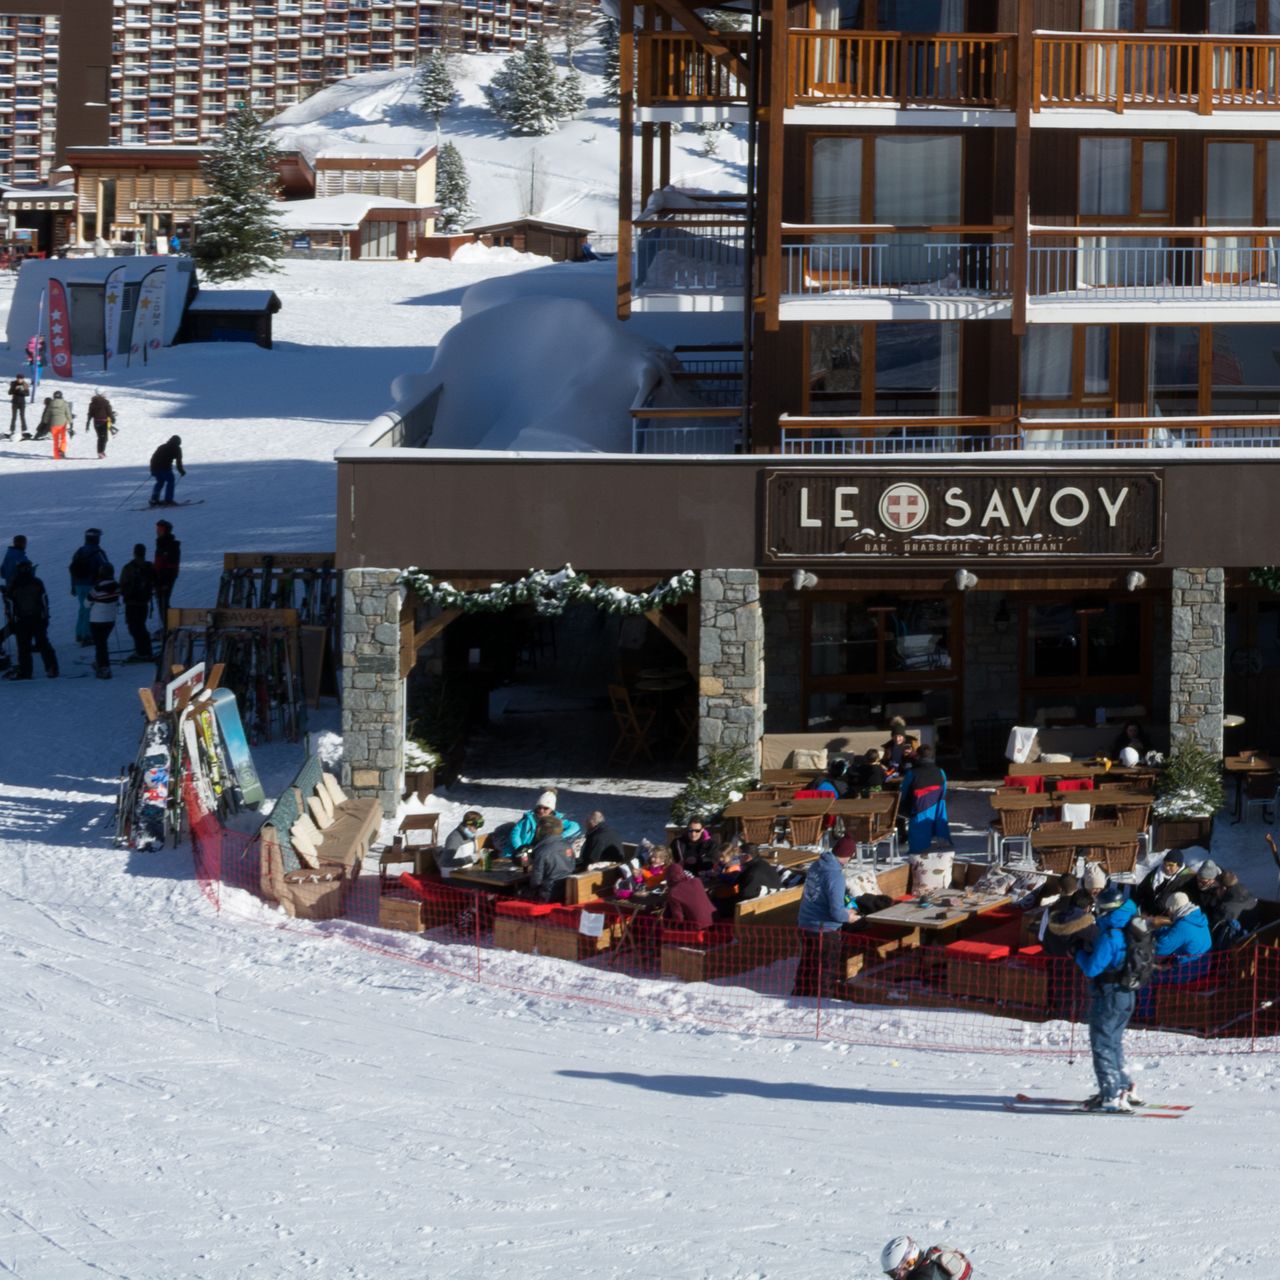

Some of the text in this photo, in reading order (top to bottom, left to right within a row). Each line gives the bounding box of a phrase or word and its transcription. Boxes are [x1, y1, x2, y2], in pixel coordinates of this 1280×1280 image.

[800, 486, 1130, 527] LE SAVOY
[864, 543, 1063, 552] BAR BRASSERIE RESTAURANT
